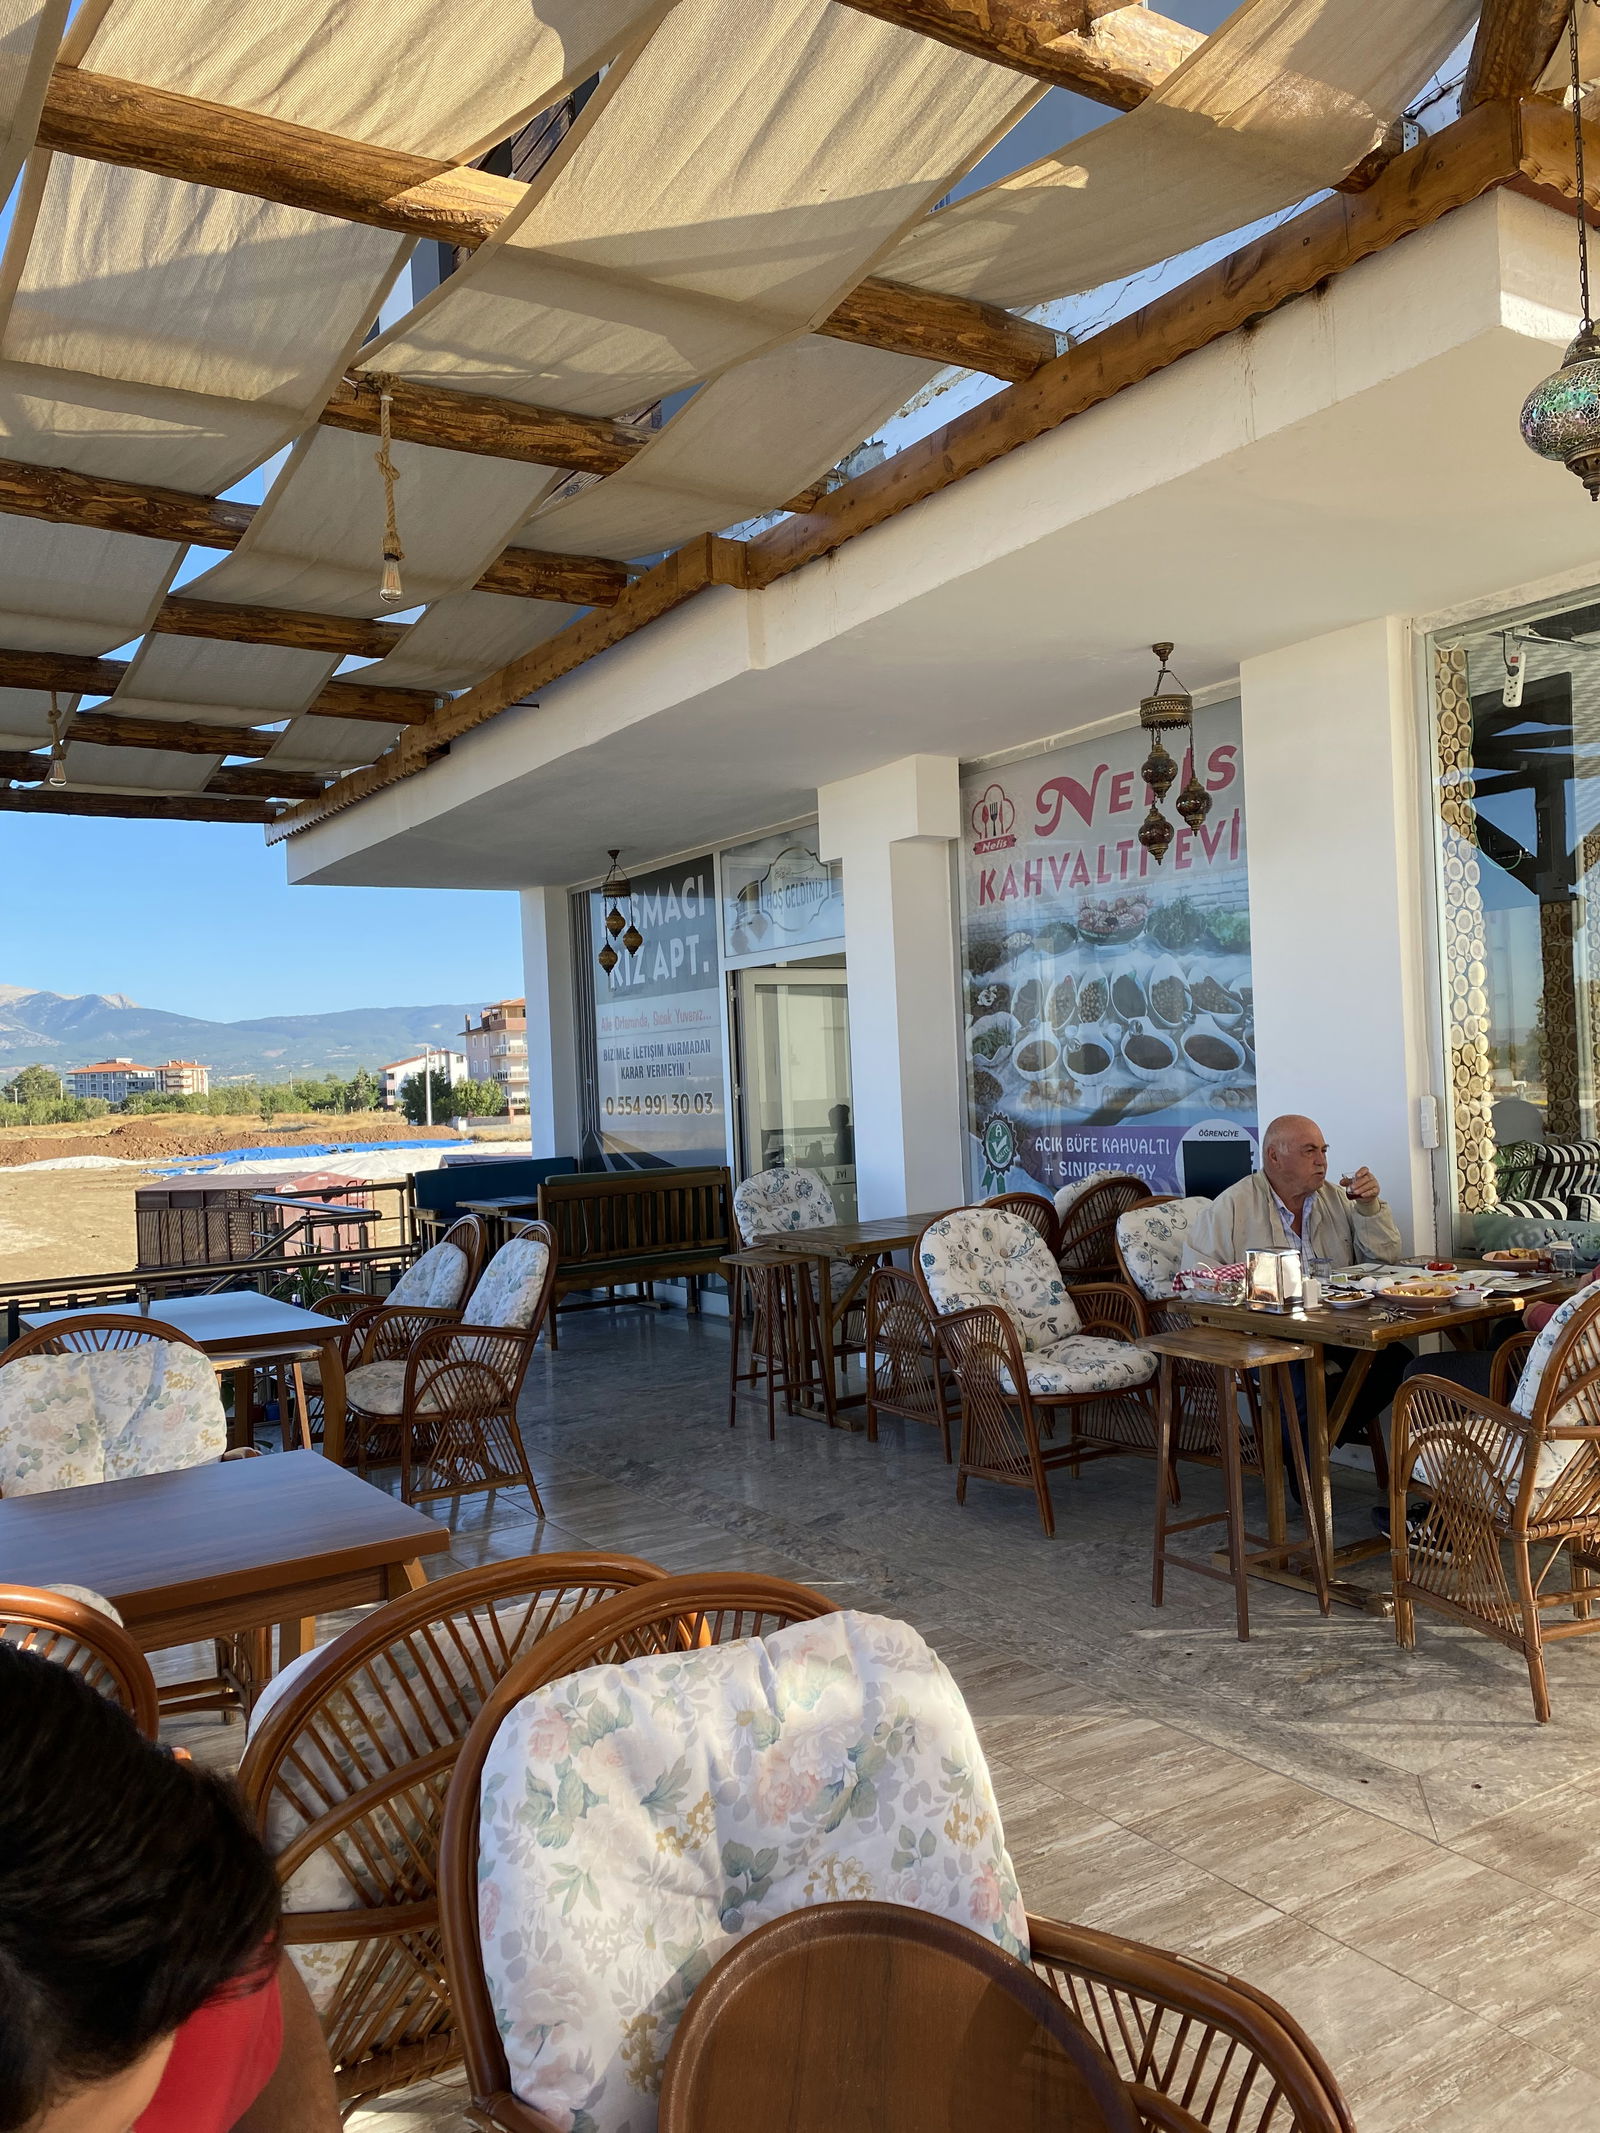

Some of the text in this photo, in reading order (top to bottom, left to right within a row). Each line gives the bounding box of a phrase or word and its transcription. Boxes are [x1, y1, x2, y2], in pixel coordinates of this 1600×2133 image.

[1035, 745, 1237, 836] NEİS
[979, 808, 1240, 906] KAHVALTI EVİ
[785, 877, 824, 909] GELDİNİZ
[653, 934, 710, 981] APT.
[633, 1041, 664, 1060] İLETİŞİM
[667, 1039, 711, 1057] KURMADAN
[621, 1065, 644, 1080] KARAR
[646, 1060, 685, 1078] VERMEYİN
[606, 1092, 713, 1116] 0 554 991 30 03
[1035, 1134, 1170, 1155] AÇIK BÜFE KAHVALTI
[1198, 1129, 1239, 1138] ÖĞRENCİYE
